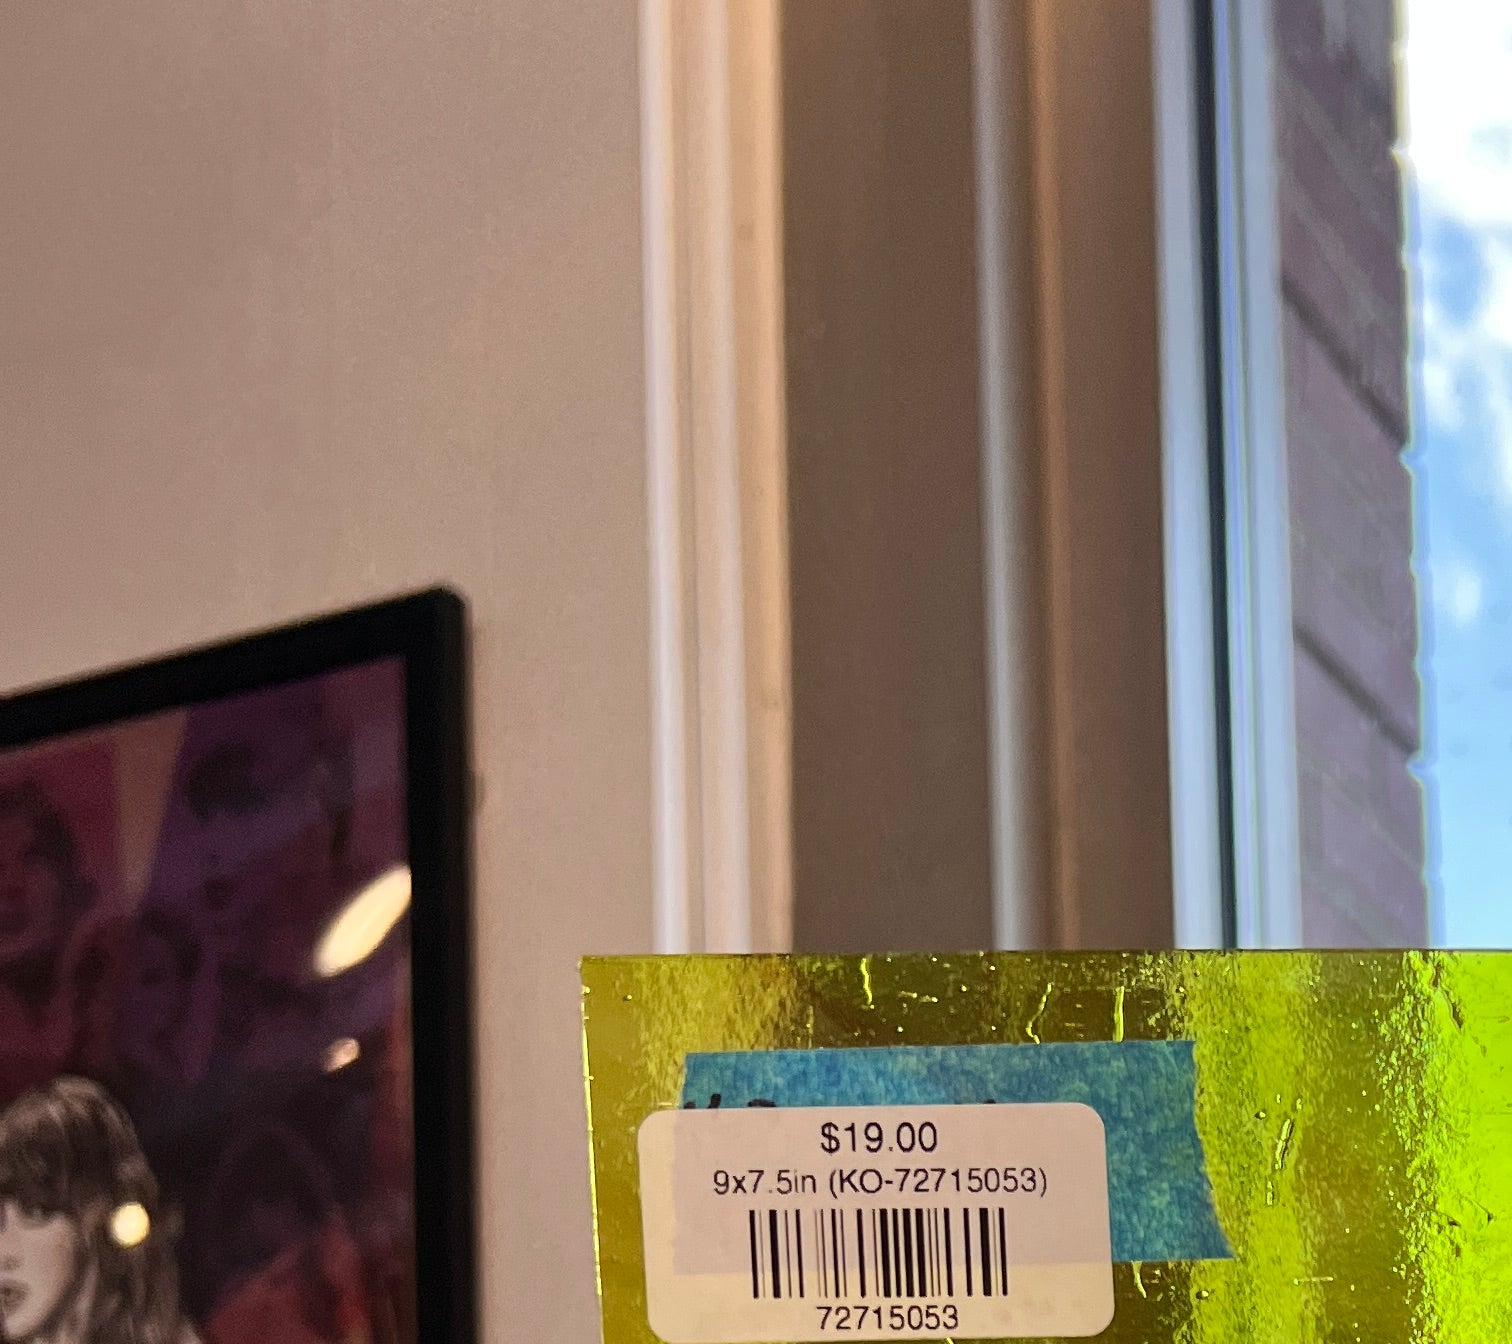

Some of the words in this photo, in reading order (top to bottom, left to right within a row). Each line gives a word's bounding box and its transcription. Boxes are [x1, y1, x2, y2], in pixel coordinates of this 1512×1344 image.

[820, 1121, 939, 1155] $19.00
[712, 1168, 818, 1196] 9x7.5in
[827, 1167, 1048, 1200] (KO-72715053)
[816, 1304, 960, 1332] 72715053
